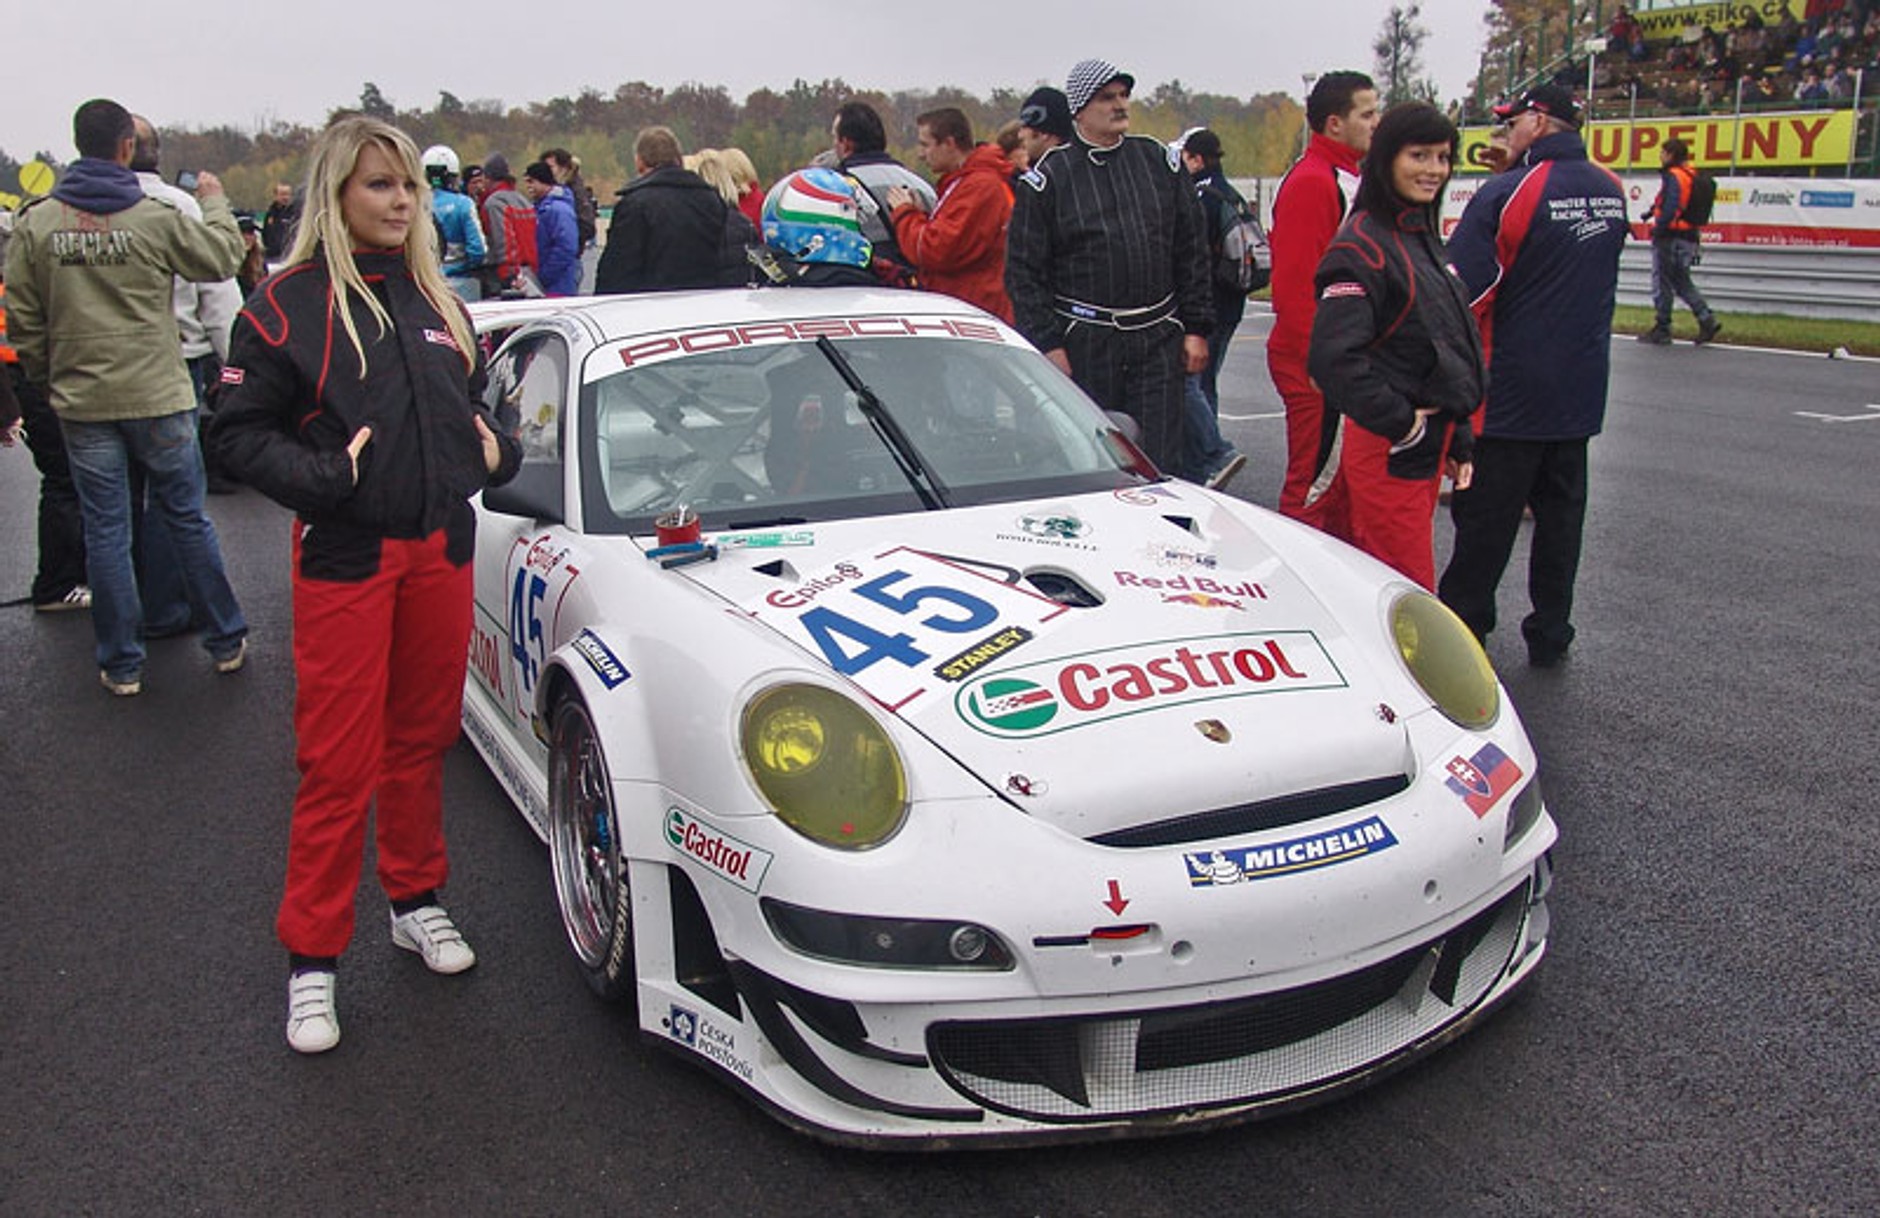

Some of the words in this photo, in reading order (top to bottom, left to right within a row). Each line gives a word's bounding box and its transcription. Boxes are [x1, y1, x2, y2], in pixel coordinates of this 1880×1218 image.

[619, 318, 1005, 367] PORSCHE
[1114, 571, 1190, 591] Red
[1193, 576, 1268, 600] Bull
[512, 567, 547, 692] 45
[798, 569, 999, 677] 45
[942, 629, 1024, 679] STANLEY
[1057, 639, 1308, 713] Castrol
[683, 822, 752, 881] Castrol
[1244, 823, 1385, 871] MICHELIN
